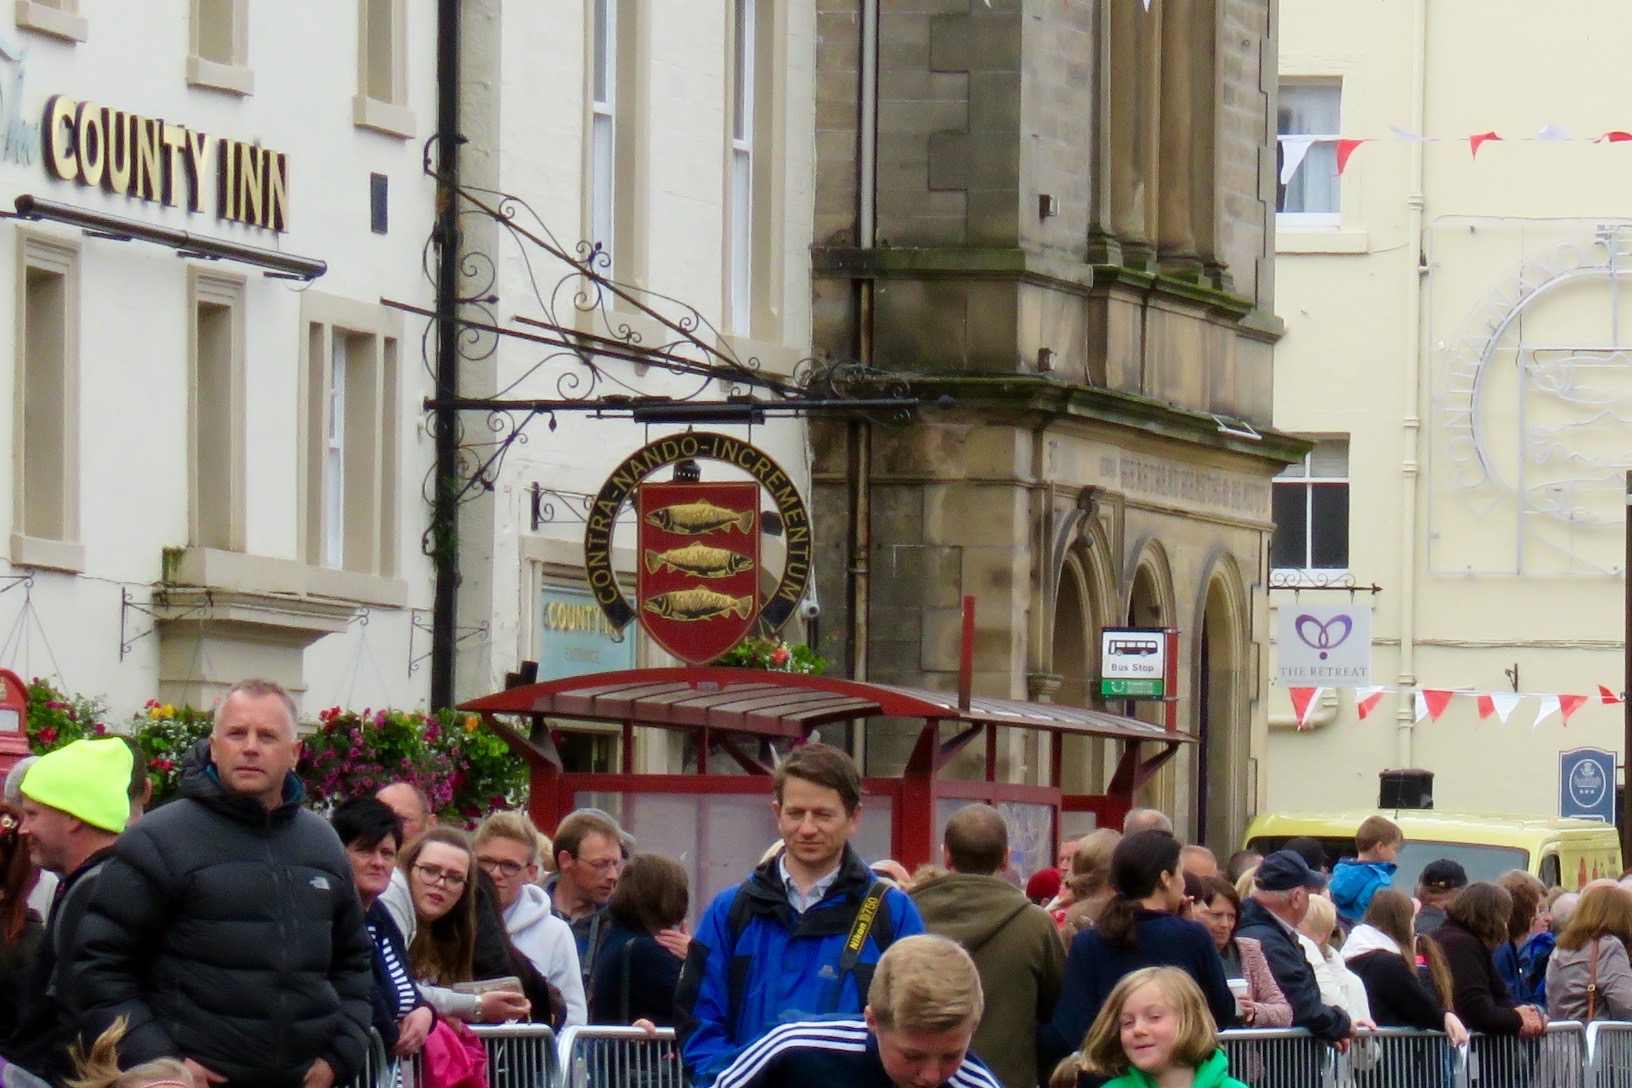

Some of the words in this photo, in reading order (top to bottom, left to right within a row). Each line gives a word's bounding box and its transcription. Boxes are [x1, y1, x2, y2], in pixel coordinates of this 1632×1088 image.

[44, 94, 208, 213] COUNTY
[217, 138, 290, 233] INN
[545, 601, 601, 632] COUNTY
[1111, 663, 1129, 671] Bus
[1132, 663, 1154, 672] Stop
[1280, 667, 1306, 676] THE
[1310, 667, 1367, 676] RETREAT
[849, 922, 867, 951] Nikon
